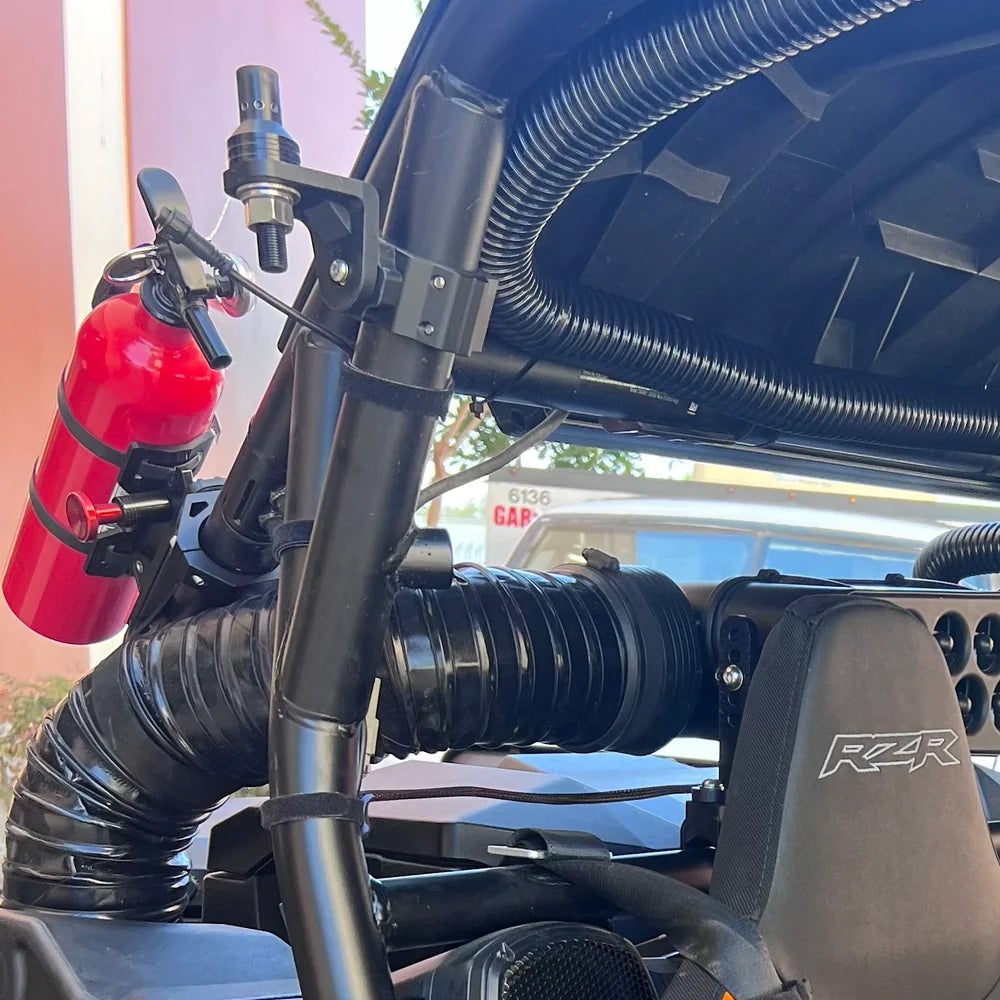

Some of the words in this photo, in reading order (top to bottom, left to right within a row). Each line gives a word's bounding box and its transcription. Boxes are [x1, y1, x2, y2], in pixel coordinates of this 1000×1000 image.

[509, 488, 550, 505] 6136
[494, 505, 538, 527] GAR
[818, 729, 961, 779] RZR
